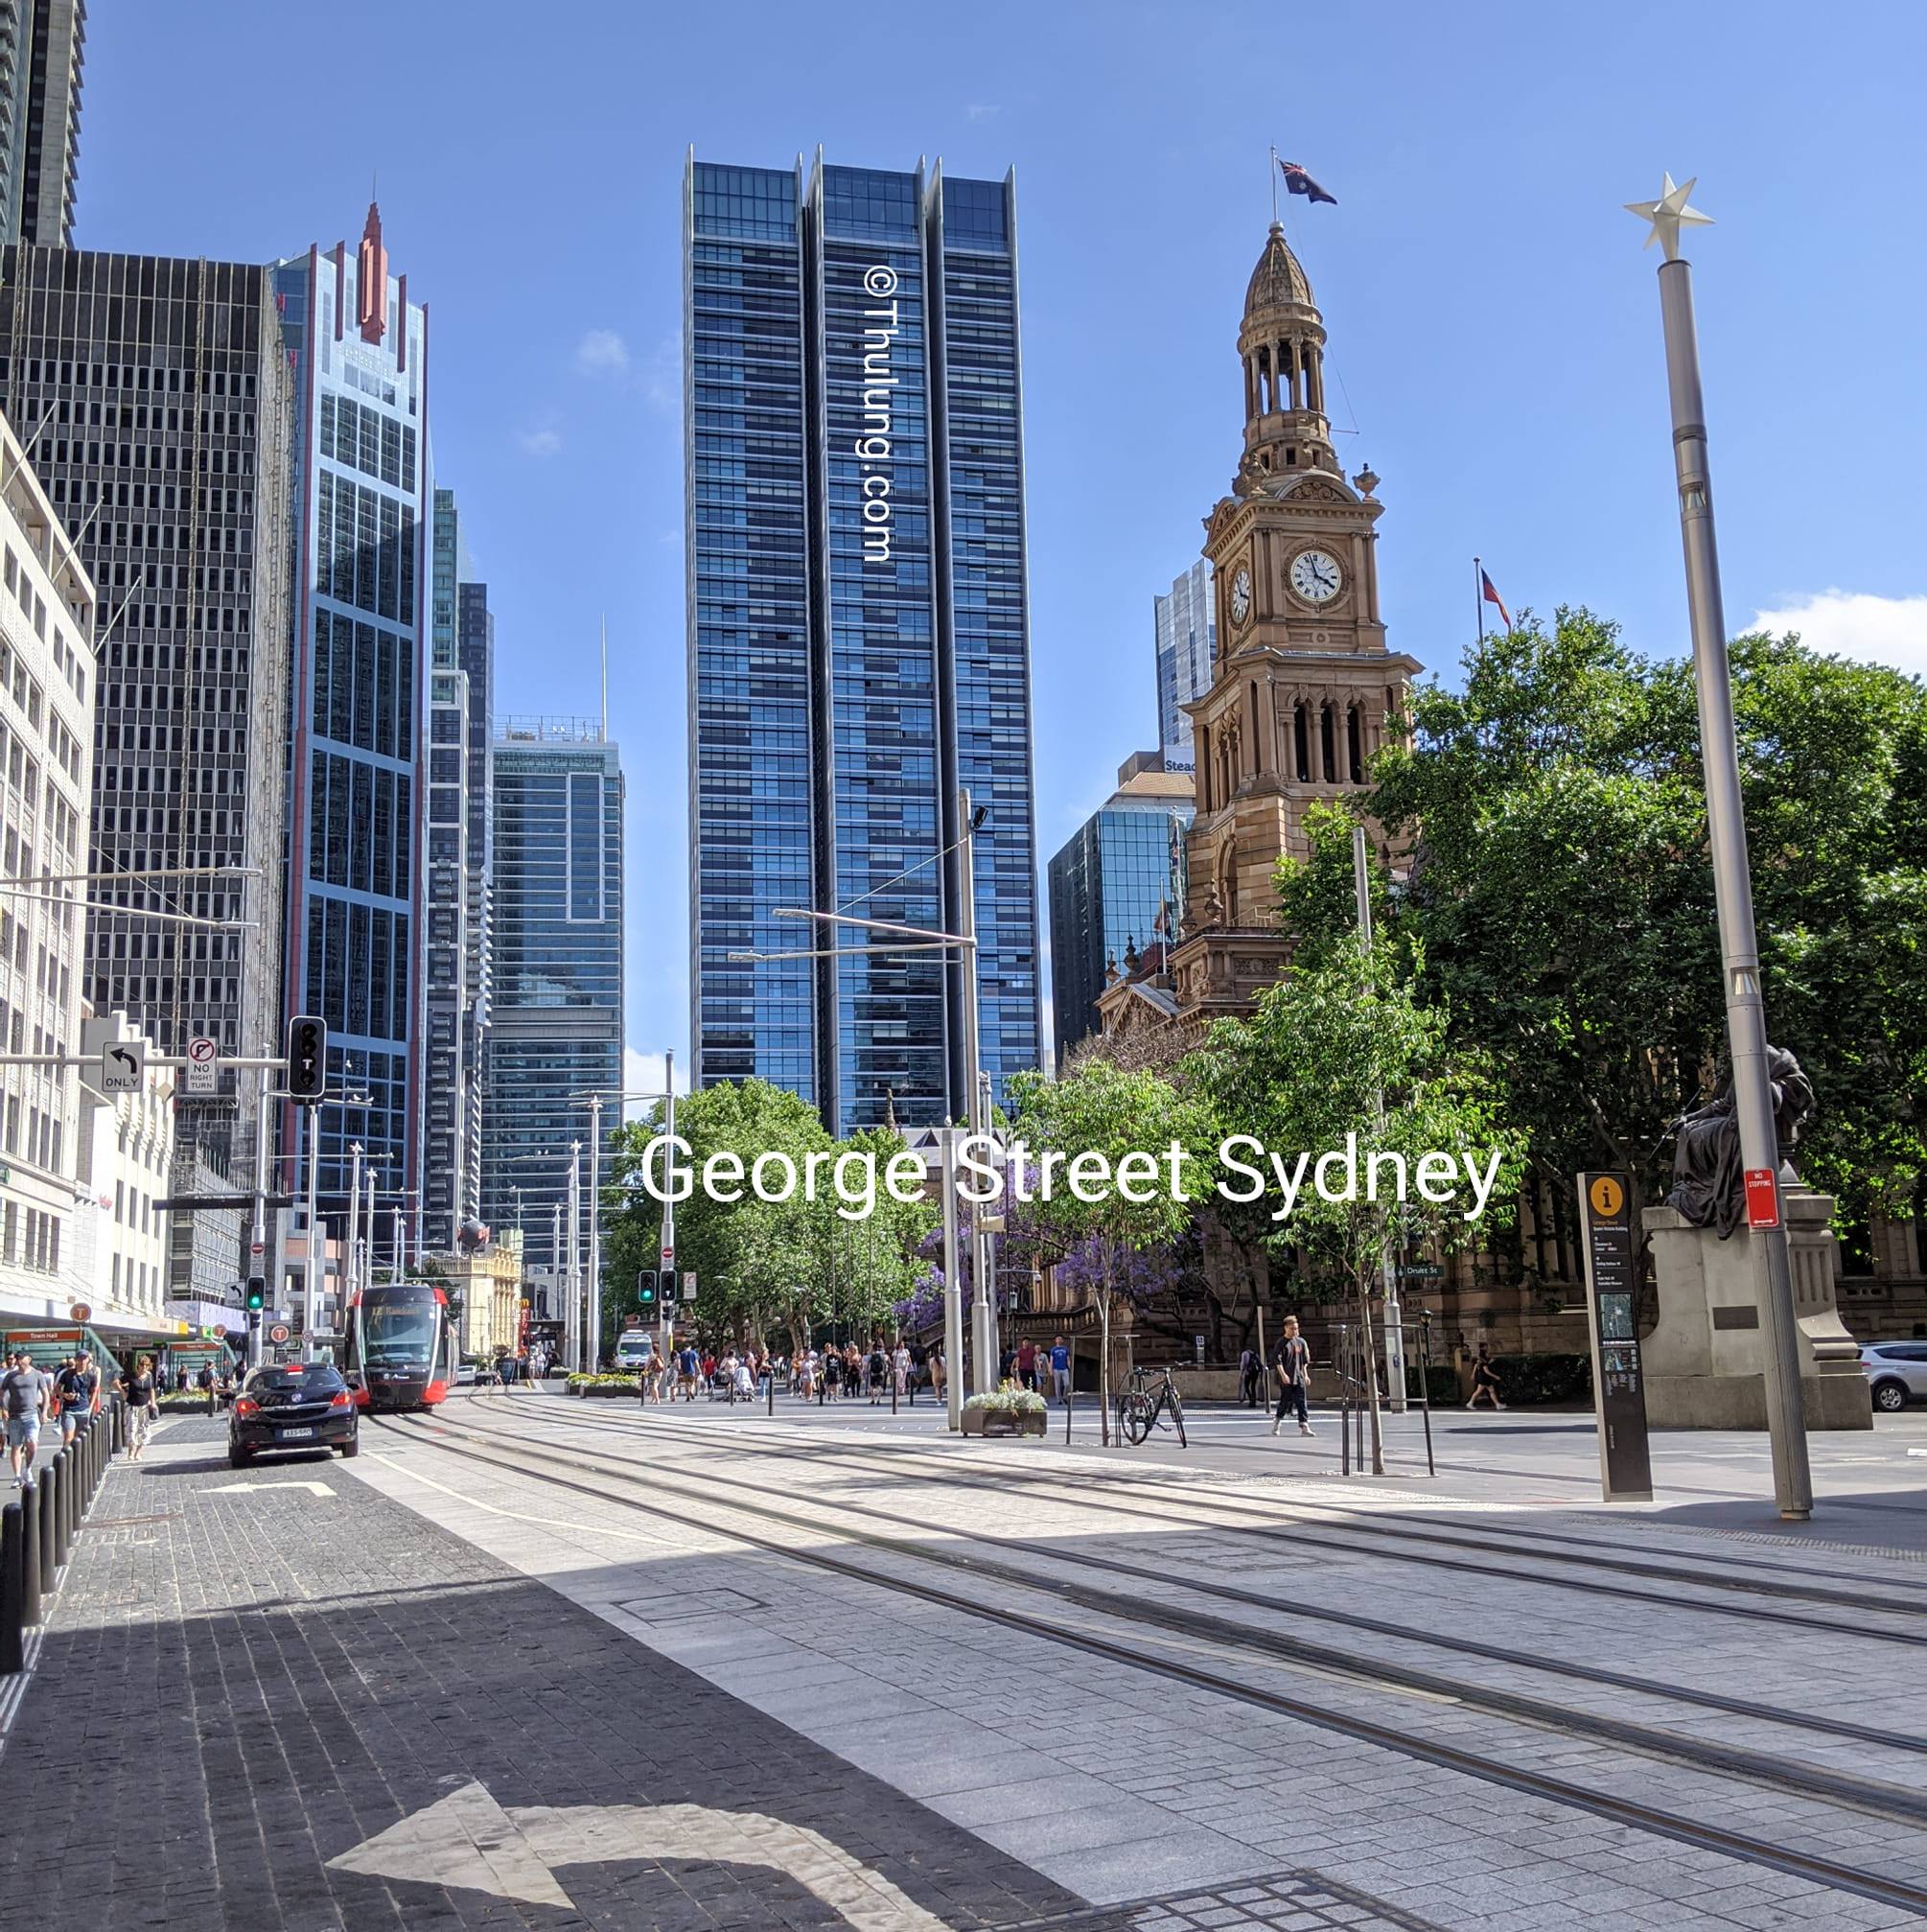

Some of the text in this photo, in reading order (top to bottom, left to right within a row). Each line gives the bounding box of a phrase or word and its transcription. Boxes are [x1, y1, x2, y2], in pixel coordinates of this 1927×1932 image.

[194, 1064, 210, 1073] NO
[105, 1078, 138, 1087] ONLY
[1748, 1179, 1772, 1188] STOPPING
